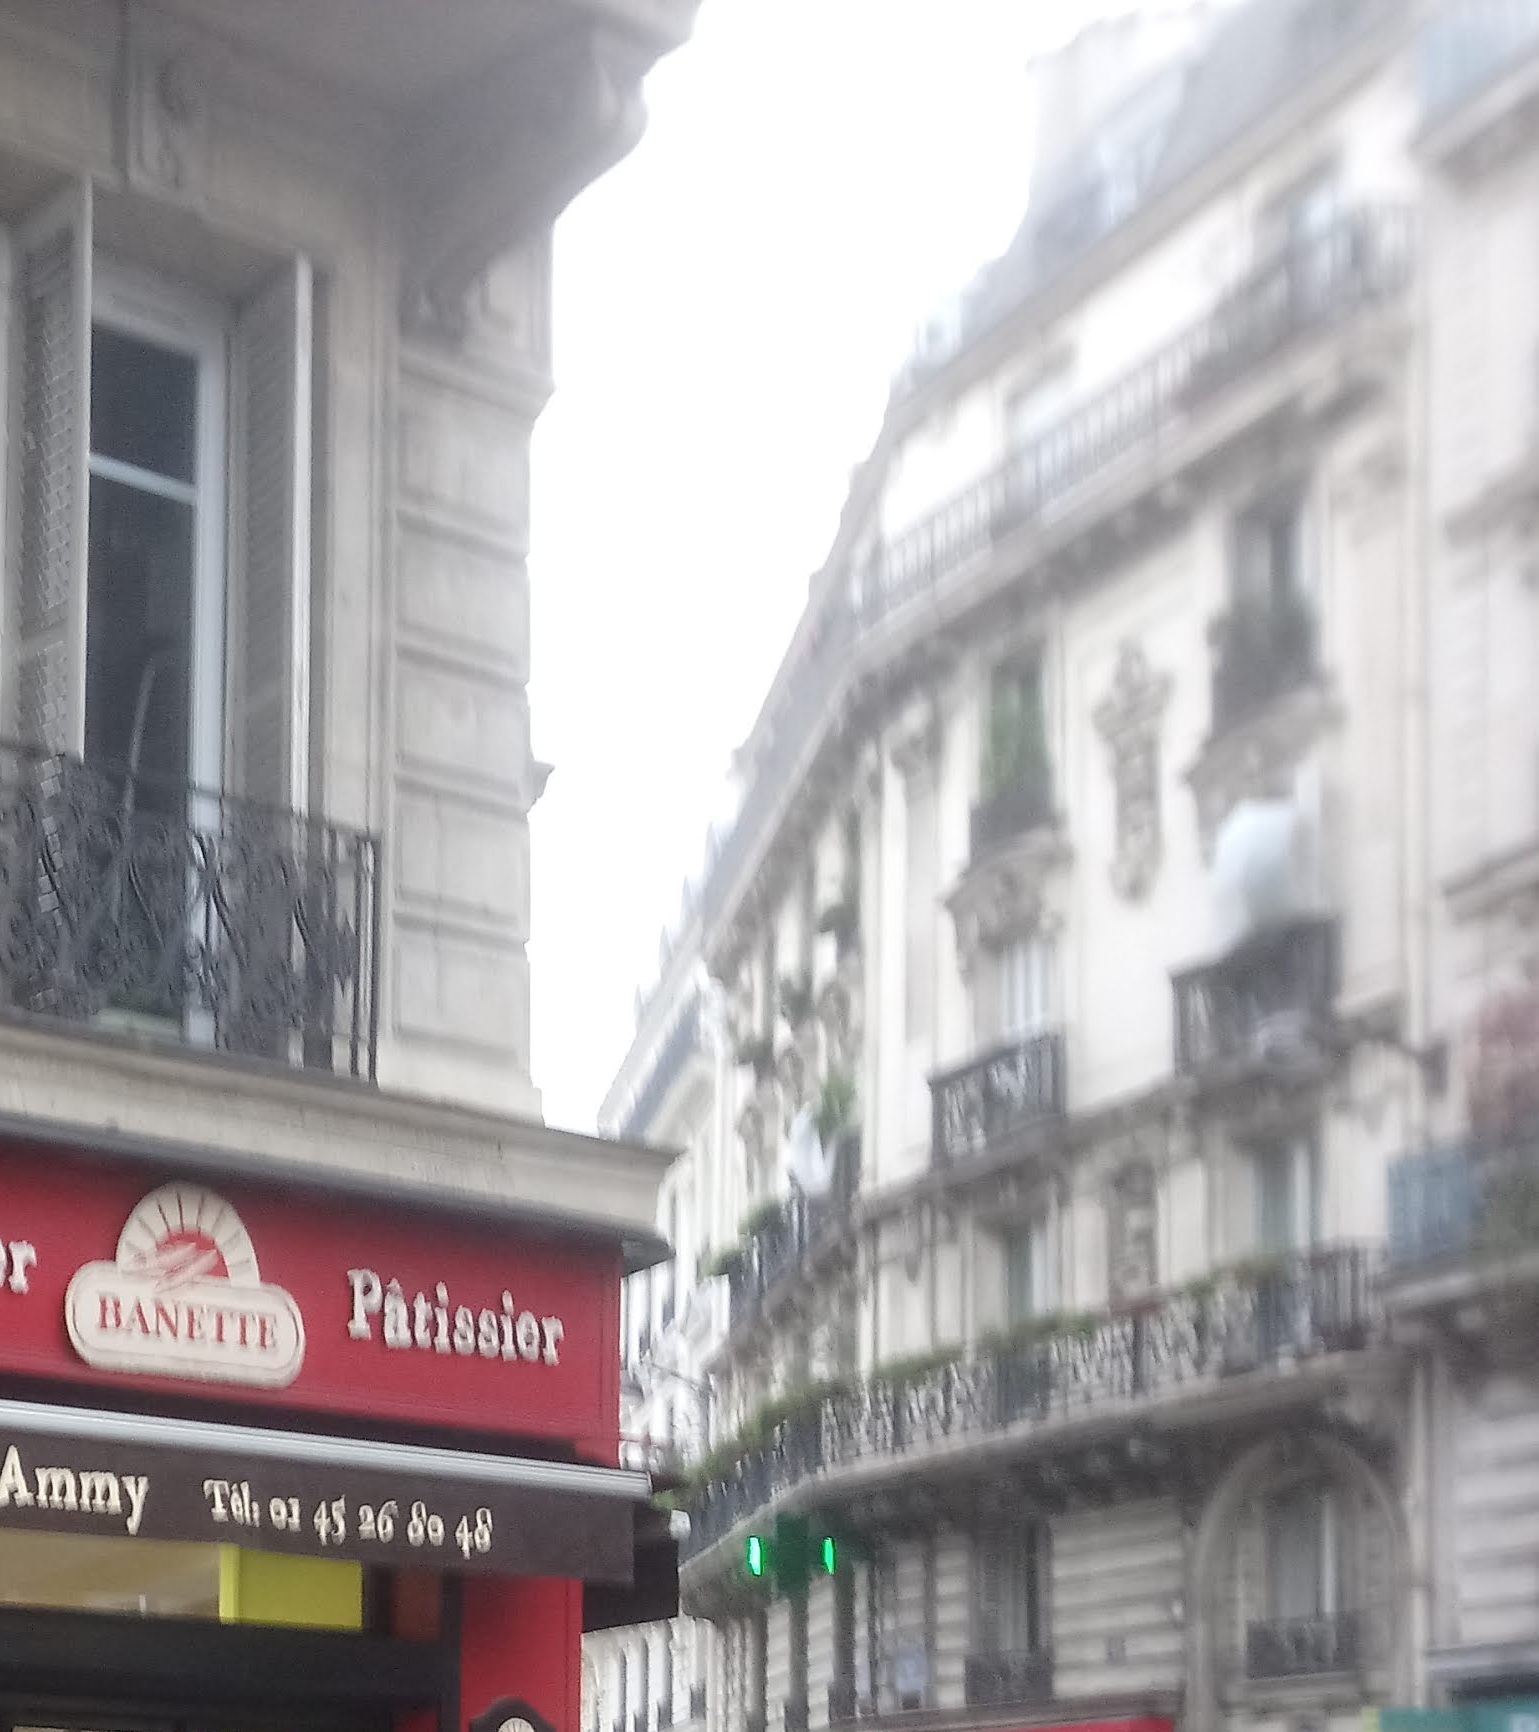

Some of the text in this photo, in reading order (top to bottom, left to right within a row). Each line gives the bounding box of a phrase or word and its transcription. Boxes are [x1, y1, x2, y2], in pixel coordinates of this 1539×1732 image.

[98, 1288, 280, 1351] BANETTE
[347, 1266, 565, 1367] Pâtissier
[269, 1497, 301, 1531] 01
[313, 1494, 347, 1546] 45
[359, 1500, 399, 1543] 26
[407, 1500, 445, 1546] 80
[455, 1507, 493, 1560] 48
